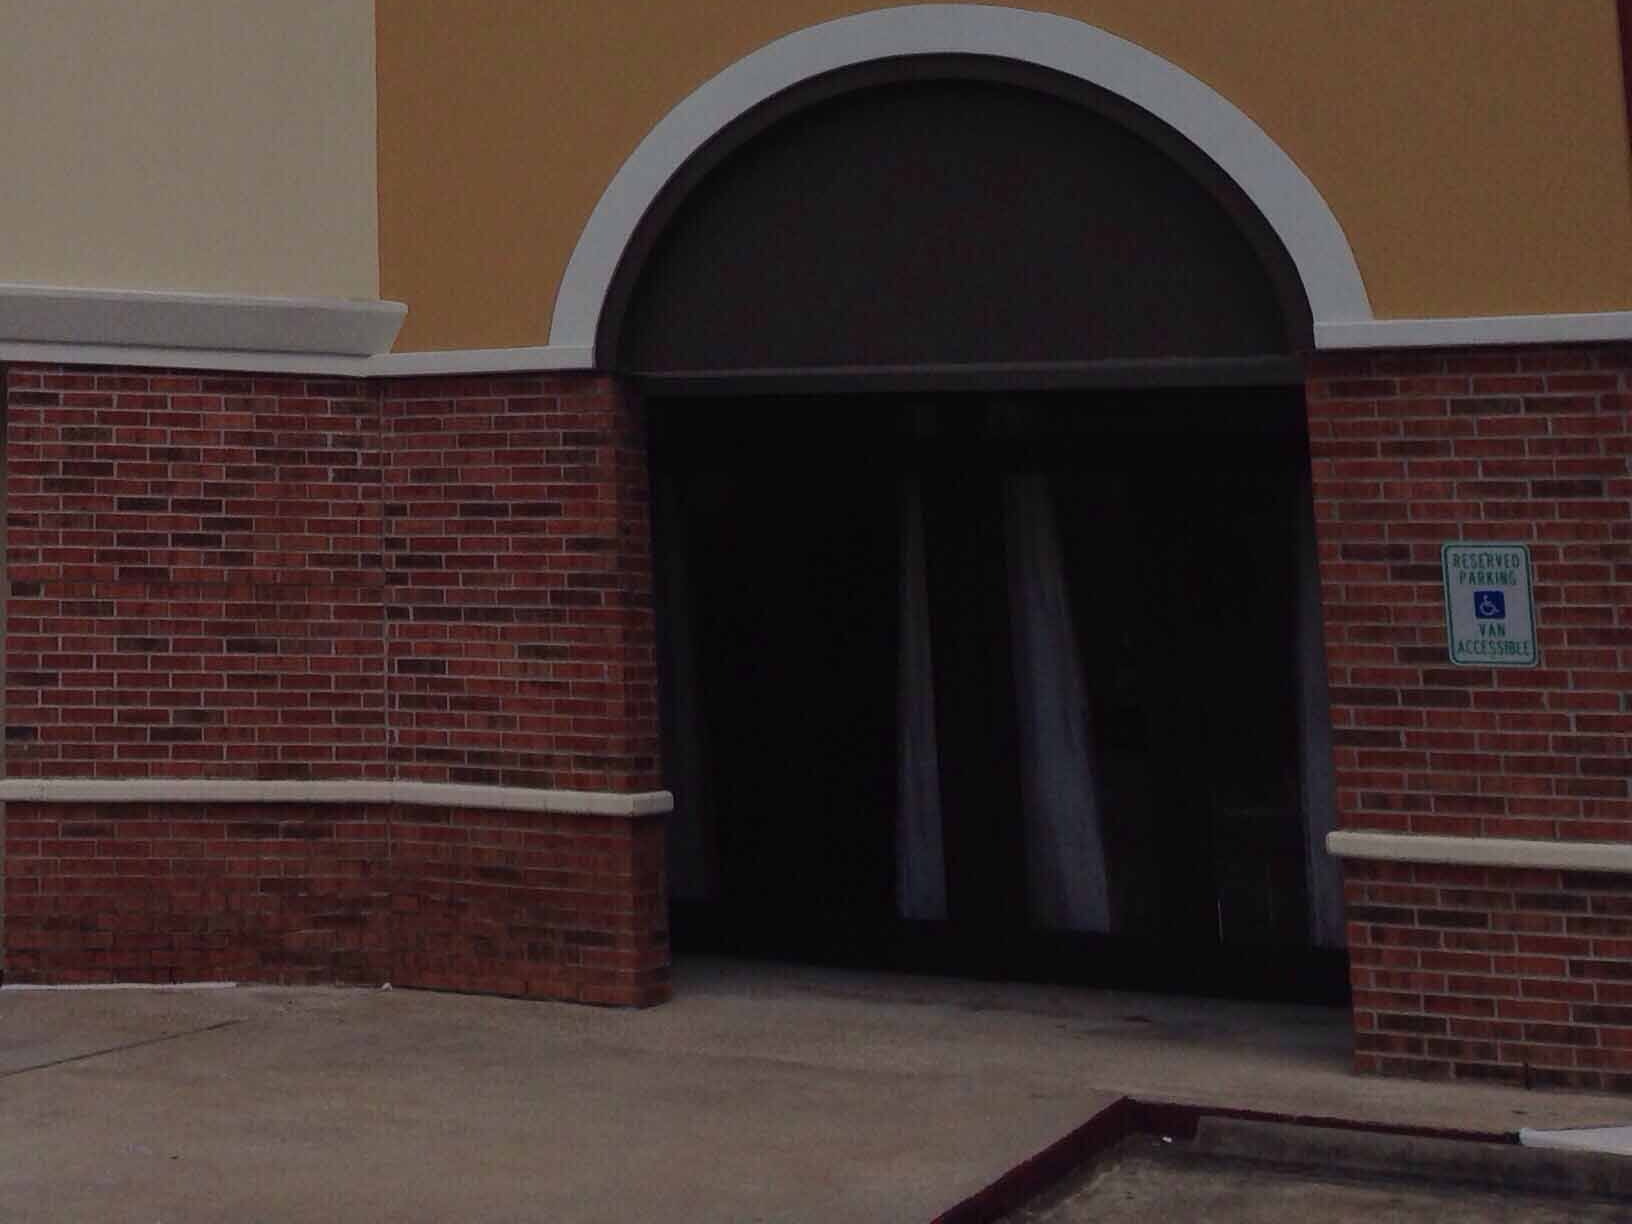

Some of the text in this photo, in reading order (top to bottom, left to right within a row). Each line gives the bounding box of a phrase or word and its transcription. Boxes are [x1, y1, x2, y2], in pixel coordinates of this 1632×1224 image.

[1453, 553, 1520, 569] RESERVED
[1459, 569, 1517, 585] PARKING
[1479, 623, 1506, 637] VAN
[1457, 639, 1529, 657] ACCESSIBLE
